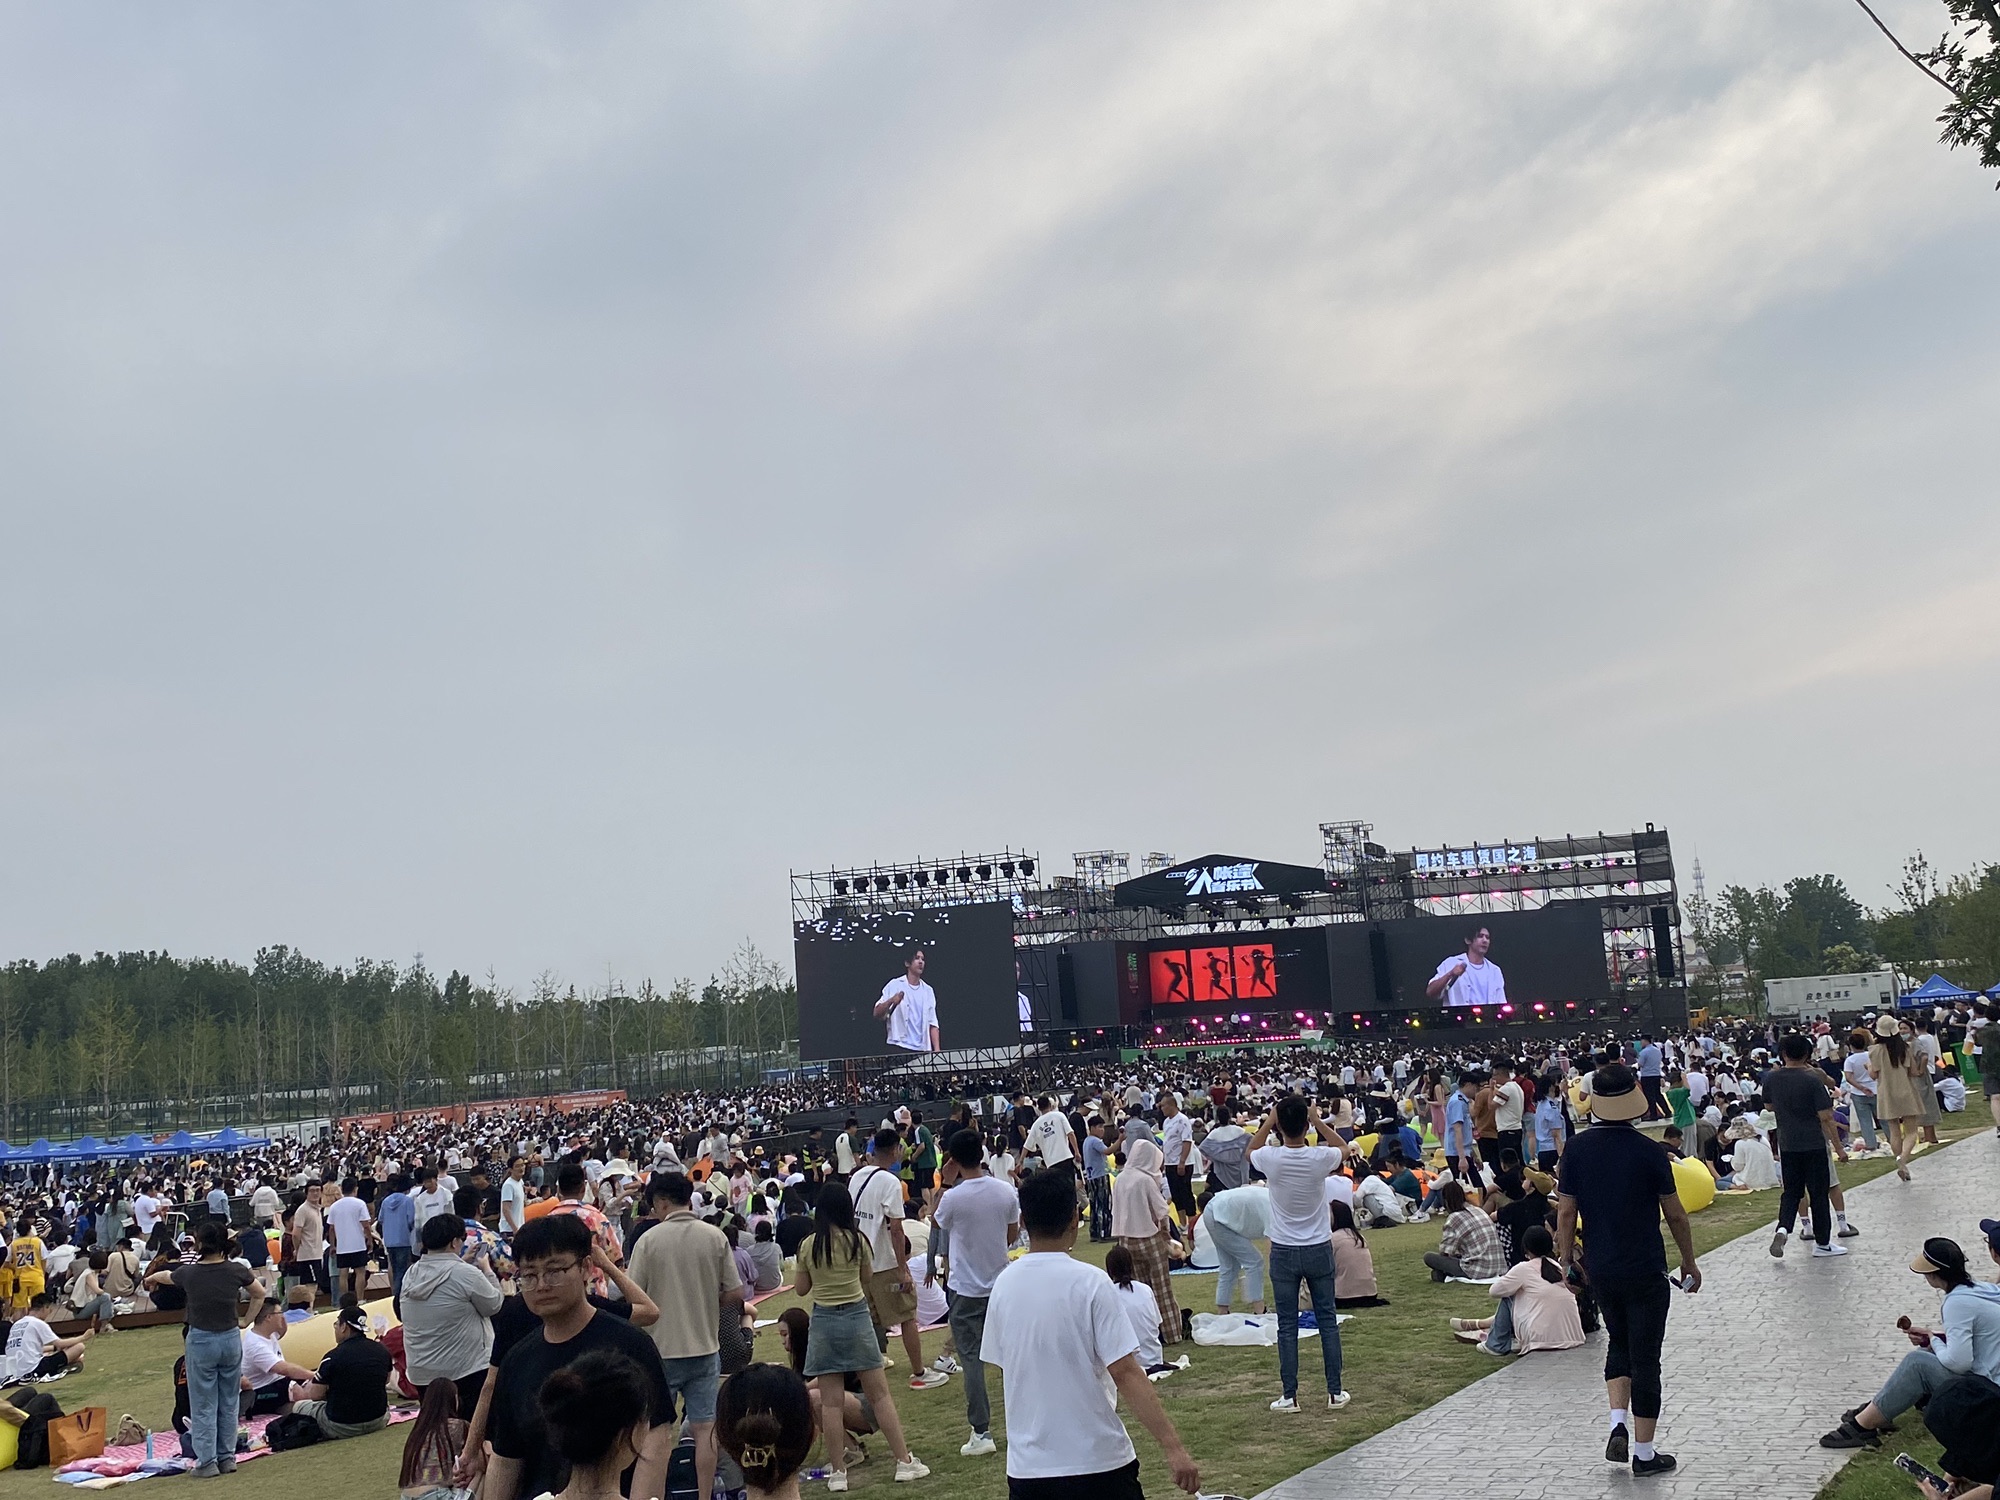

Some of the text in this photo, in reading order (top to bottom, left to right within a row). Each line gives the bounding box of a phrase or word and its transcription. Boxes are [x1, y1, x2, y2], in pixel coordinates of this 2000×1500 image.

[1211, 879, 1255, 893] 音乐节
[1806, 990, 1851, 1000] 应急电源车
[16, 1251, 35, 1268] 24
